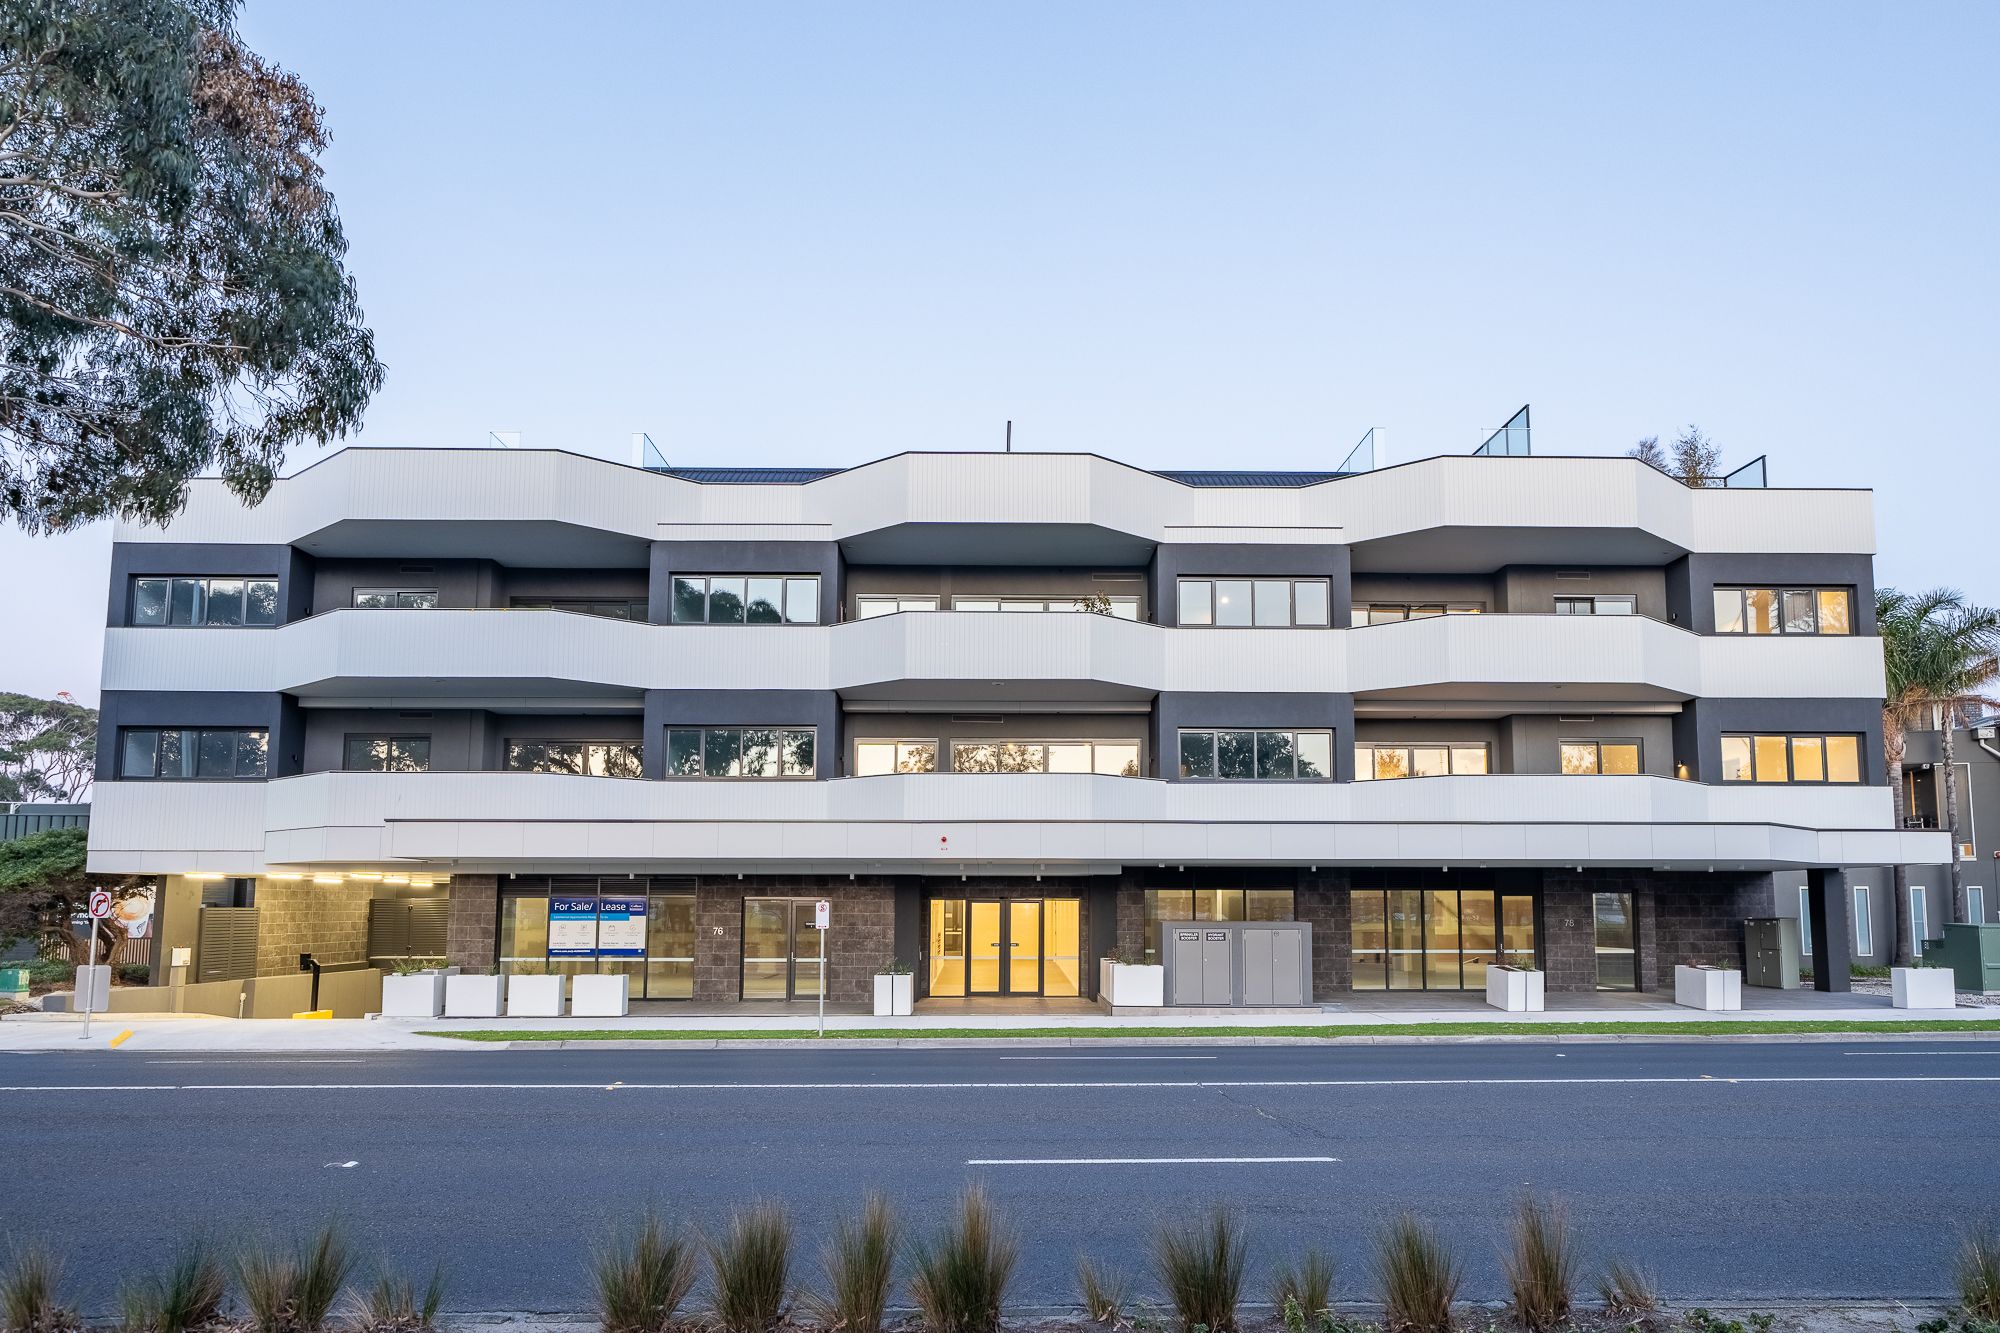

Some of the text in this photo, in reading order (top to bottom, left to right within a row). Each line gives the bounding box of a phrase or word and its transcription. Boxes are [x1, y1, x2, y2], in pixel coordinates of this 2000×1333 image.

[554, 902, 626, 911] For Sale/ Lease
[1564, 919, 1575, 927] 78
[713, 927, 724, 935] 76
